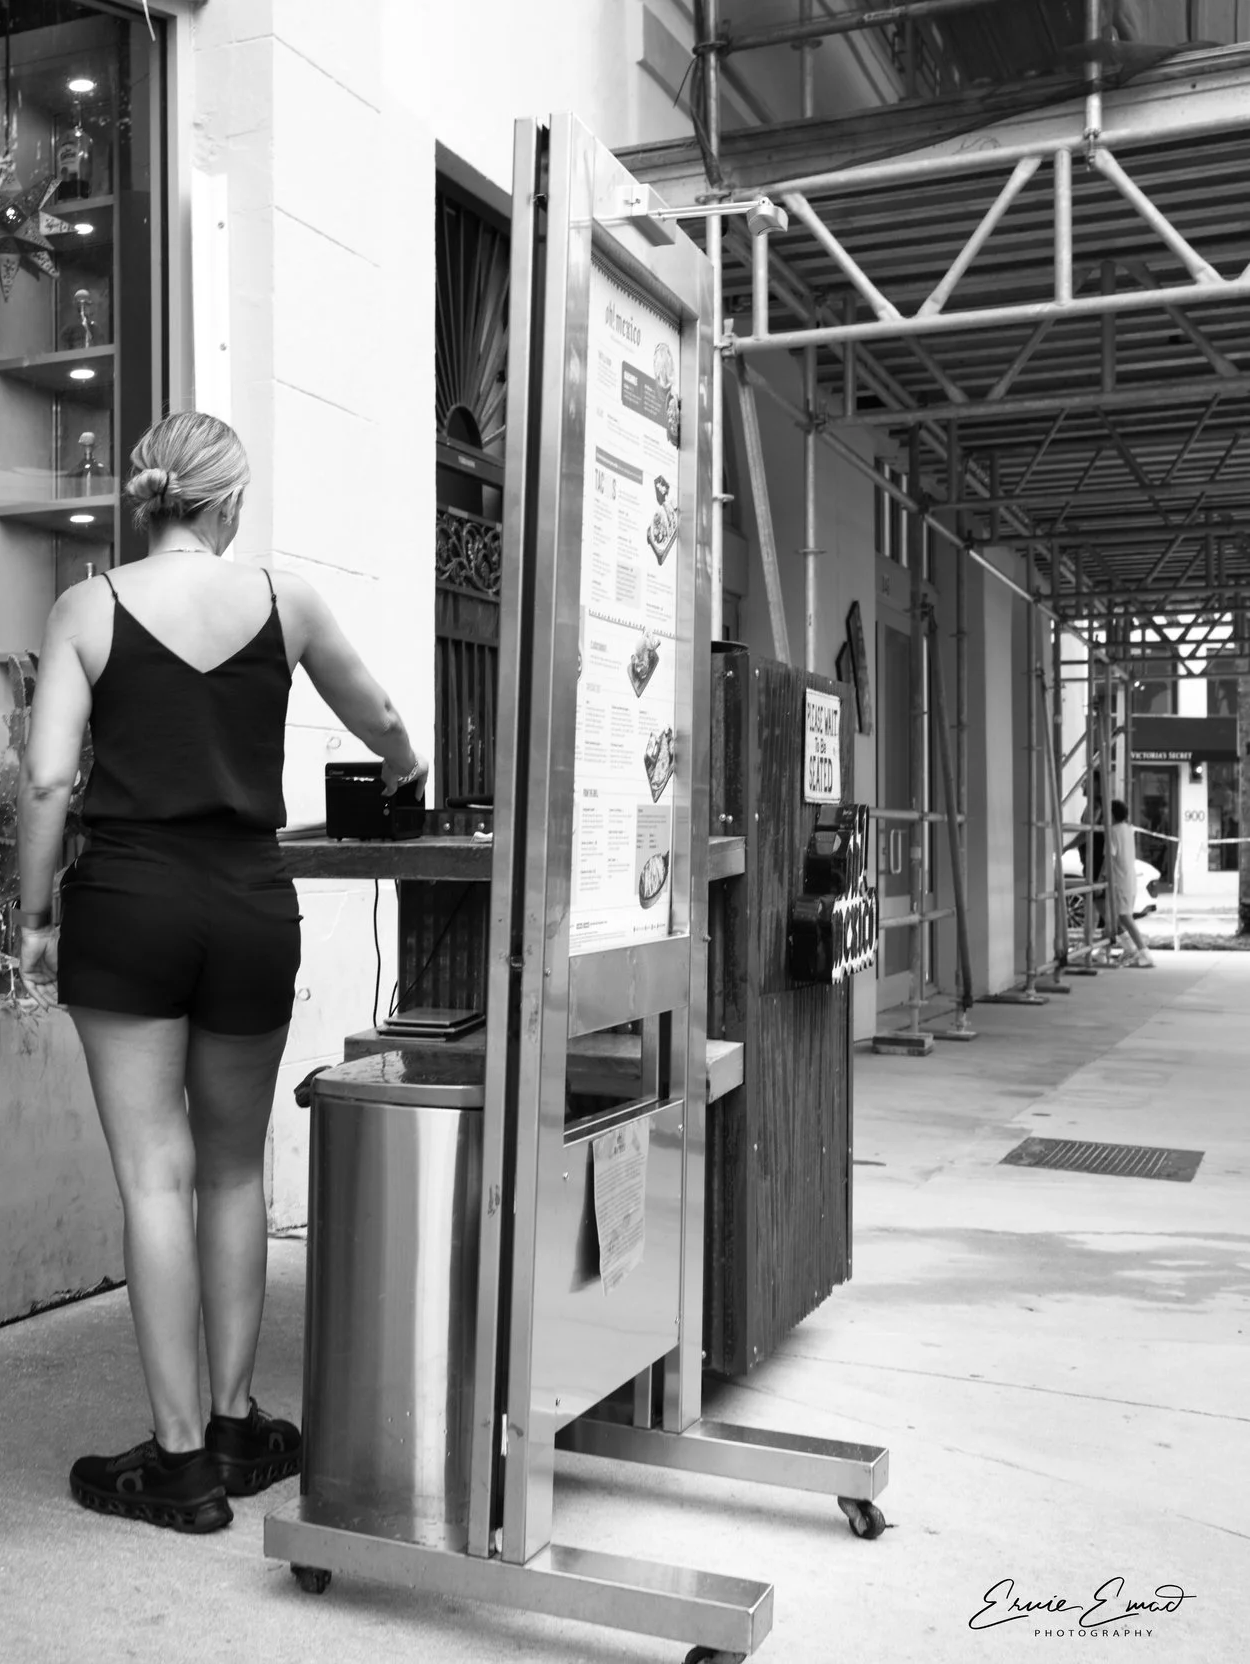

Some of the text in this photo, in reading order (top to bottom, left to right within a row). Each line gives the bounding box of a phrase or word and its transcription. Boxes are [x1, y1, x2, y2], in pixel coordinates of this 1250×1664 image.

[616, 314, 641, 346] mexico
[807, 702, 838, 737] PLEASE WAIT
[1130, 751, 1193, 760] VICTORIA'S SECRET
[809, 755, 833, 793] SEATED
[1184, 810, 1206, 822] 900
